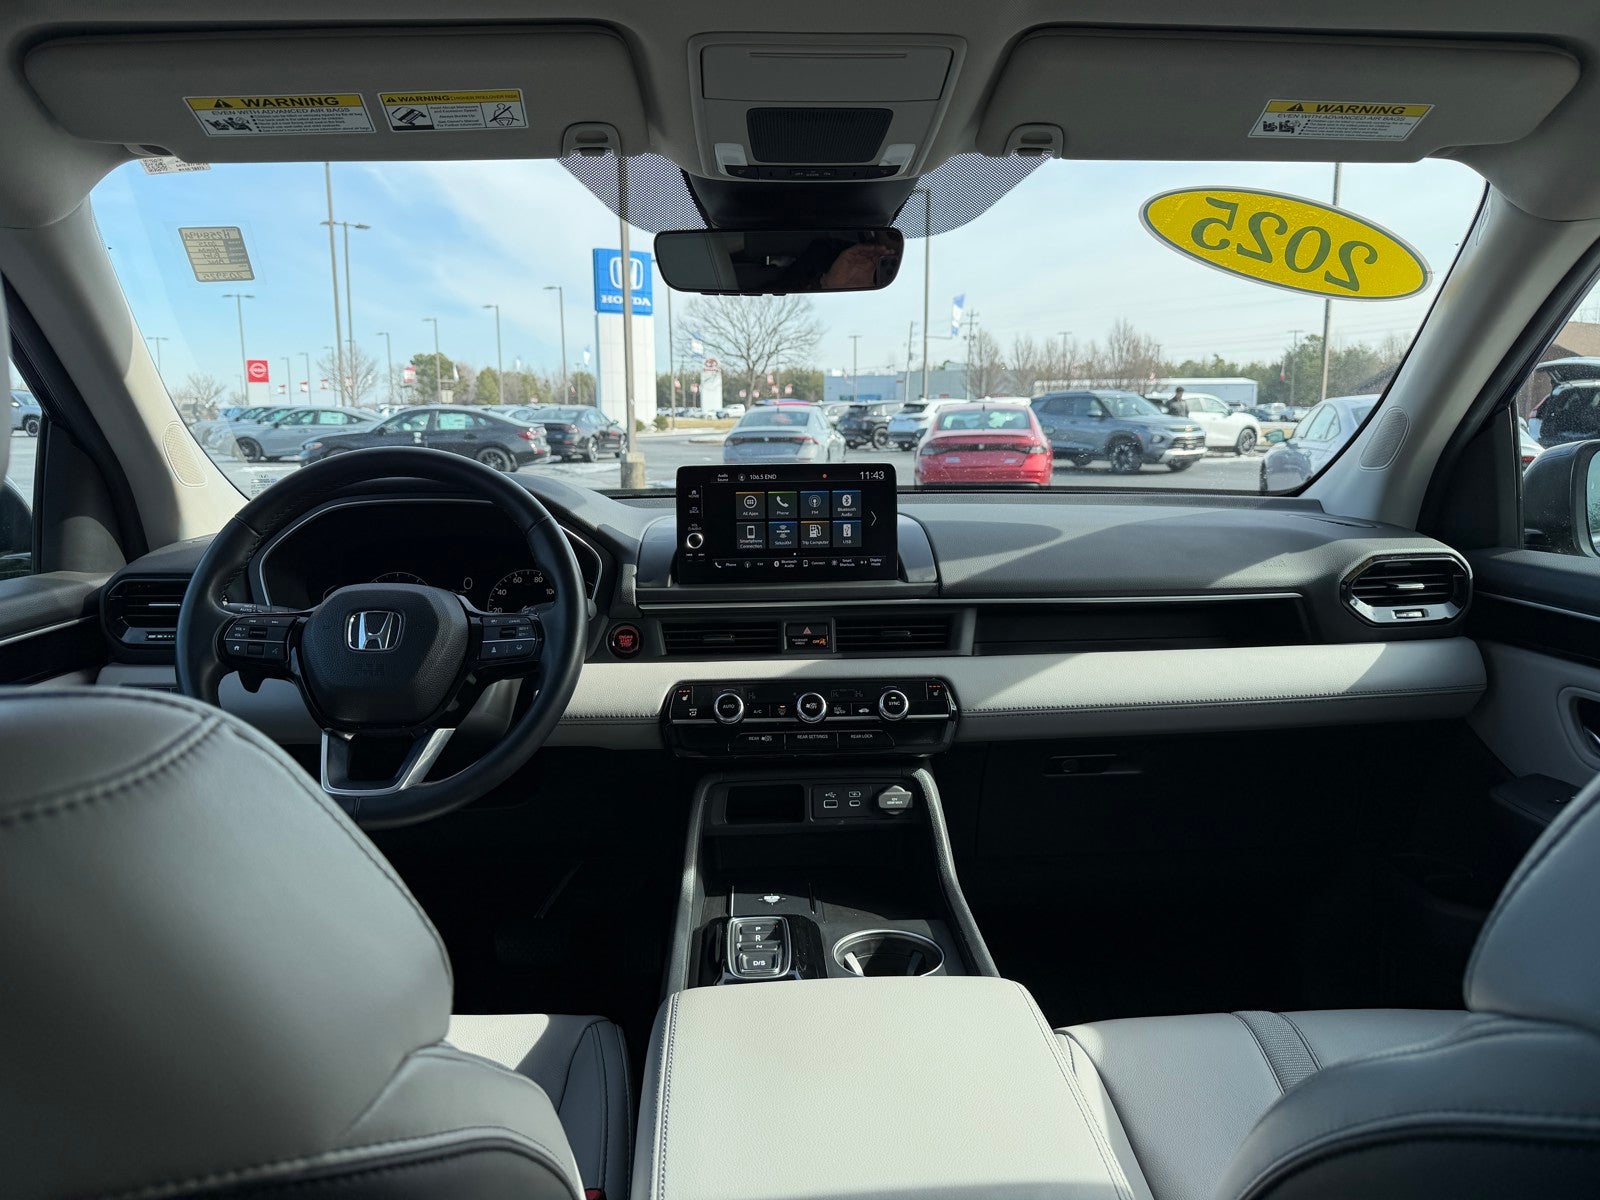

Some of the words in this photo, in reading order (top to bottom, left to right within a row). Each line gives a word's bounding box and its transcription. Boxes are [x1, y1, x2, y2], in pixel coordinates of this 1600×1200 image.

[241, 96, 340, 108] WARNING
[1315, 104, 1406, 115] WARNING
[600, 294, 652, 307] HODA
[858, 471, 885, 480] 11:43
[463, 576, 473, 590] 0
[512, 576, 523, 584] 60
[533, 576, 544, 584] 80
[755, 934, 761, 942] R
